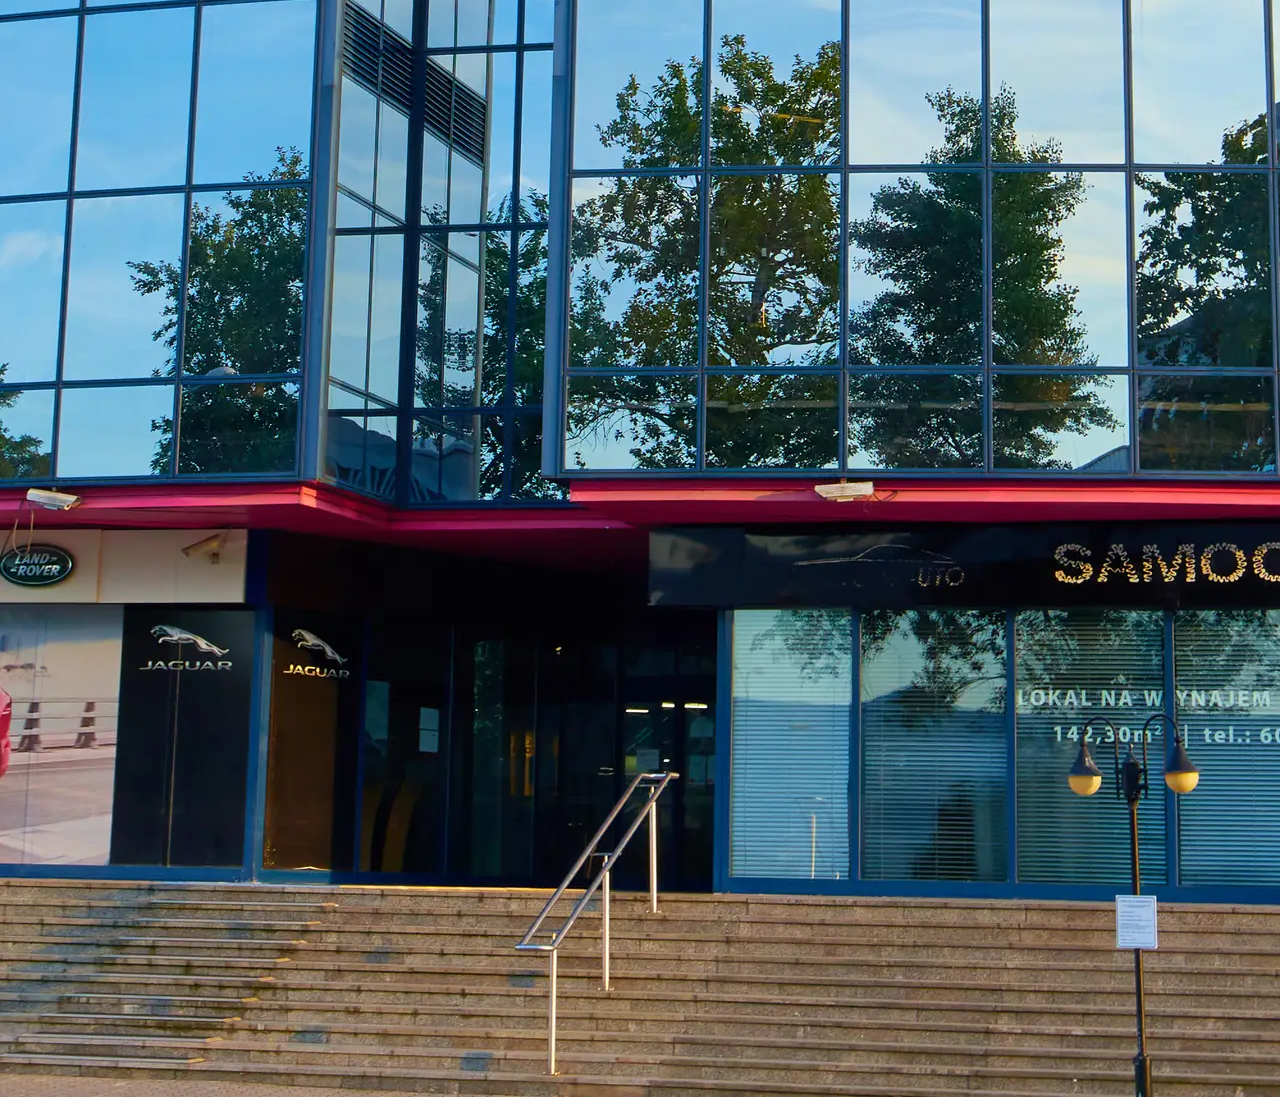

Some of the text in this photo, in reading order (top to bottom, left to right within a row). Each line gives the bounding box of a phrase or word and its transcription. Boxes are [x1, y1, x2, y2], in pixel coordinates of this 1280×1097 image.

[14, 552, 51, 565] LAND
[18, 564, 62, 577] ROVER
[138, 660, 233, 671] JAGUAR
[283, 664, 350, 680] JAGUAR
[1017, 689, 1092, 707] LOKAL
[1101, 689, 1133, 707] NA
[1203, 727, 1251, 744] tel.:
